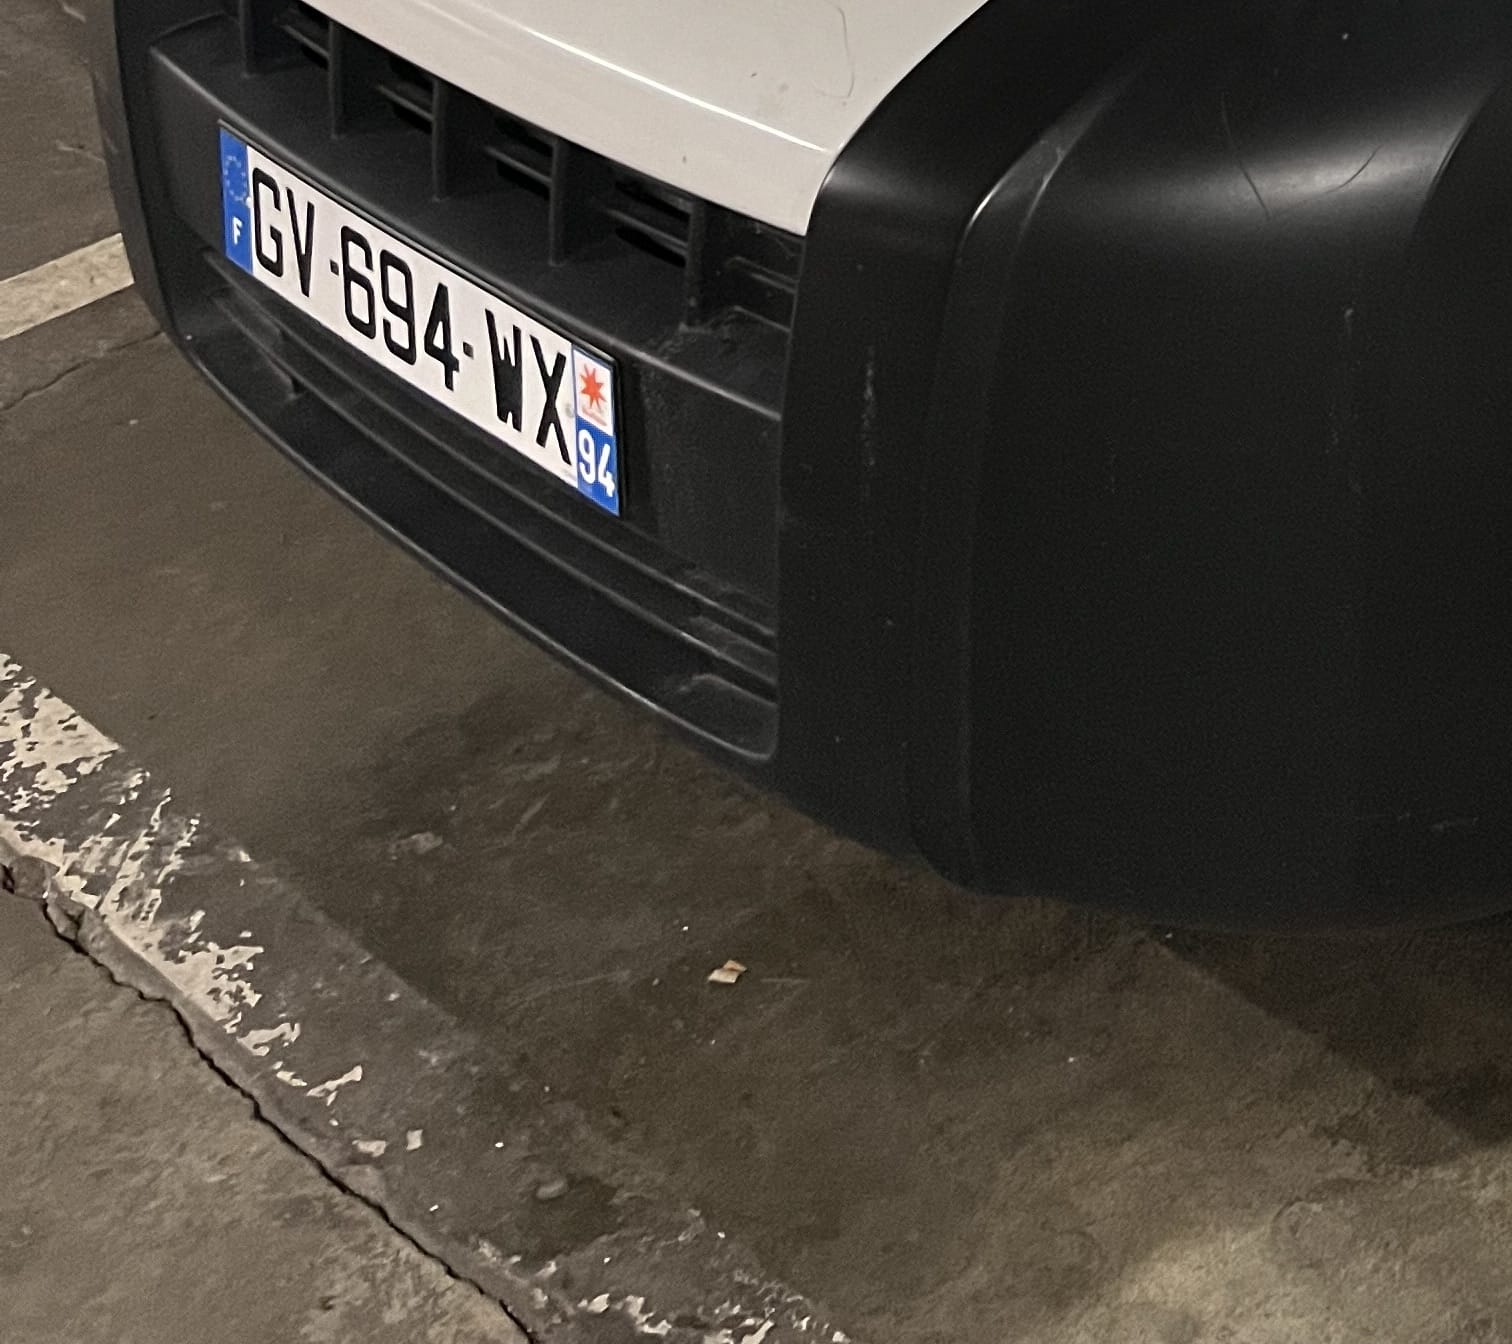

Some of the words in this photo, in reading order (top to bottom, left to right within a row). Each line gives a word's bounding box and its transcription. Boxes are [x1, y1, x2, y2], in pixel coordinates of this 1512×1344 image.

[232, 216, 243, 245] F
[252, 167, 572, 466] GV-694-WX
[577, 428, 616, 497] 94
